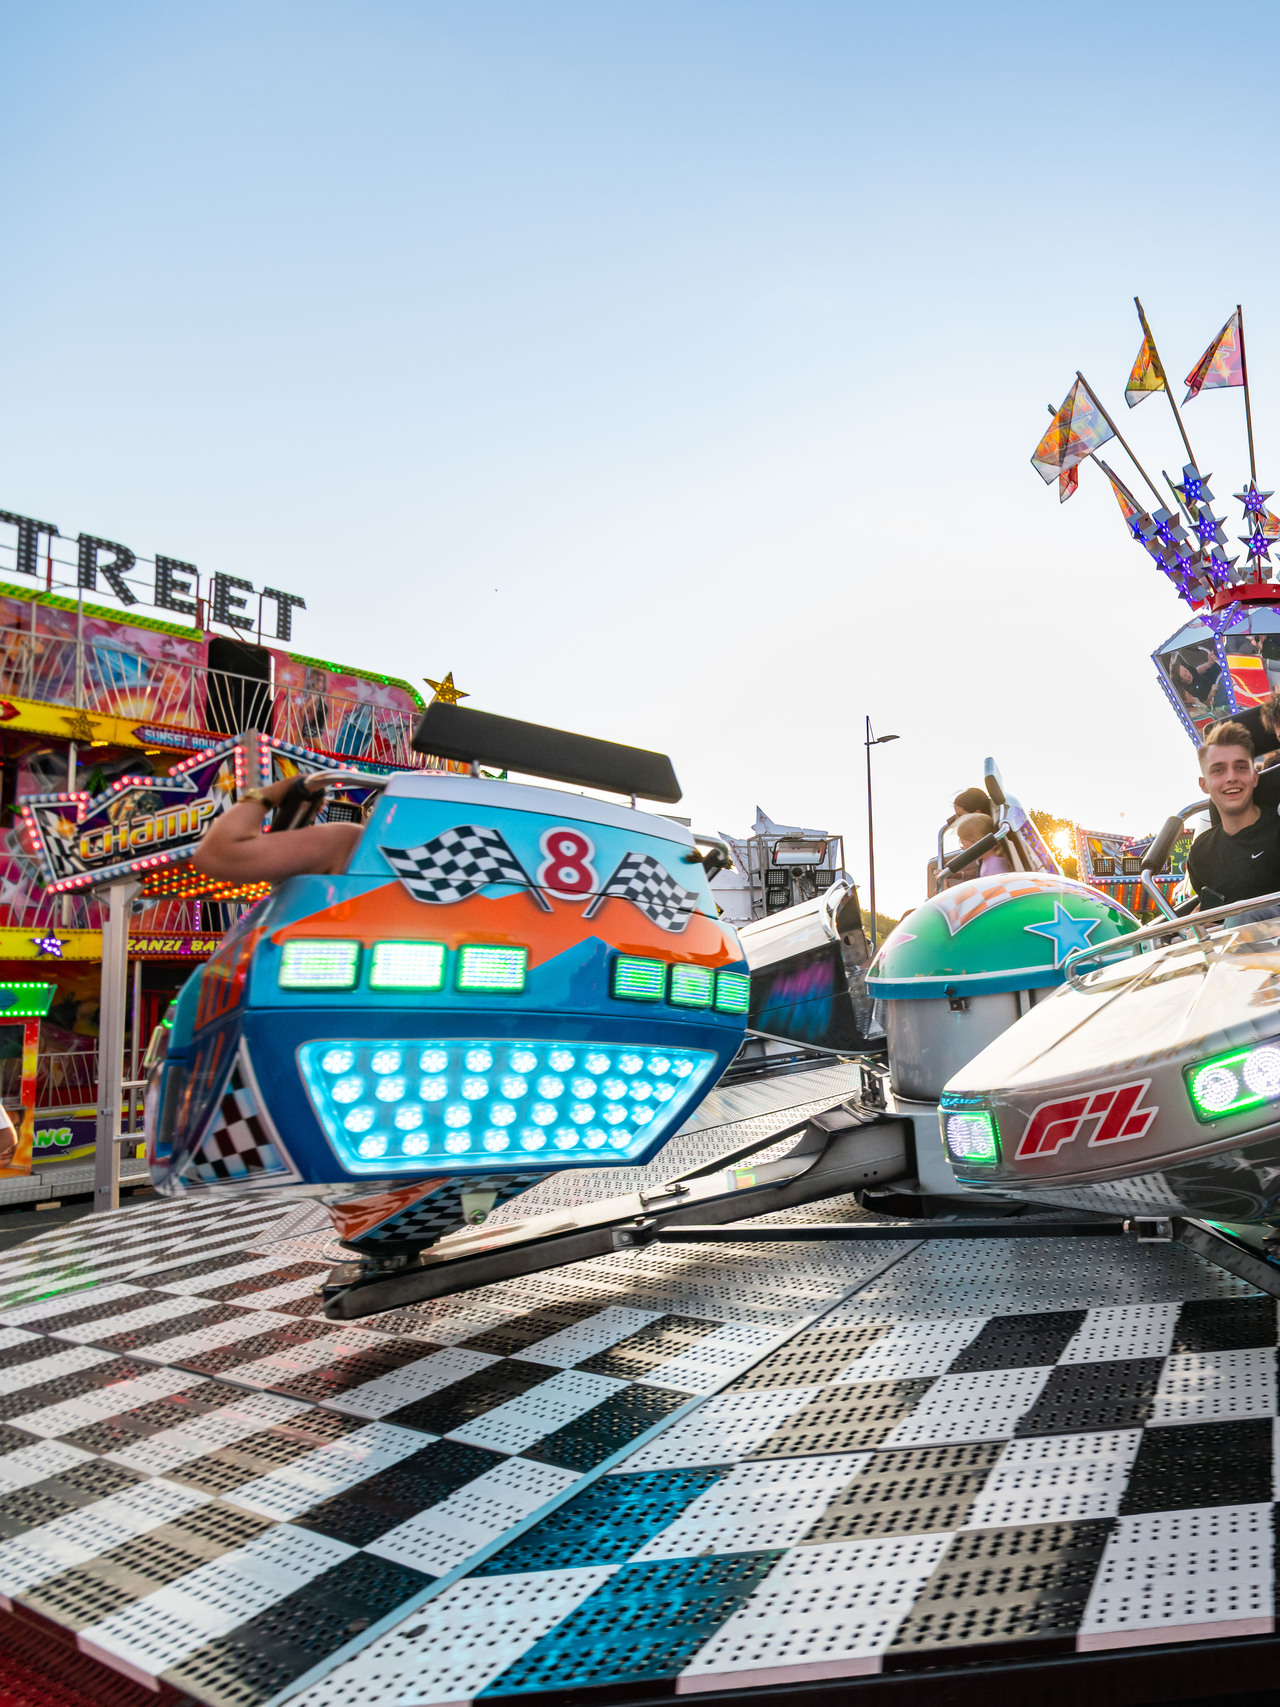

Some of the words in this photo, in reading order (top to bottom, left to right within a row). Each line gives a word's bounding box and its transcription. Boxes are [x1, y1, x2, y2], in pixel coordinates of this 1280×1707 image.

[0, 509, 307, 642] TREET
[145, 729, 187, 745] SUNSET
[537, 827, 600, 900] 8
[128, 939, 182, 951] ZANZI
